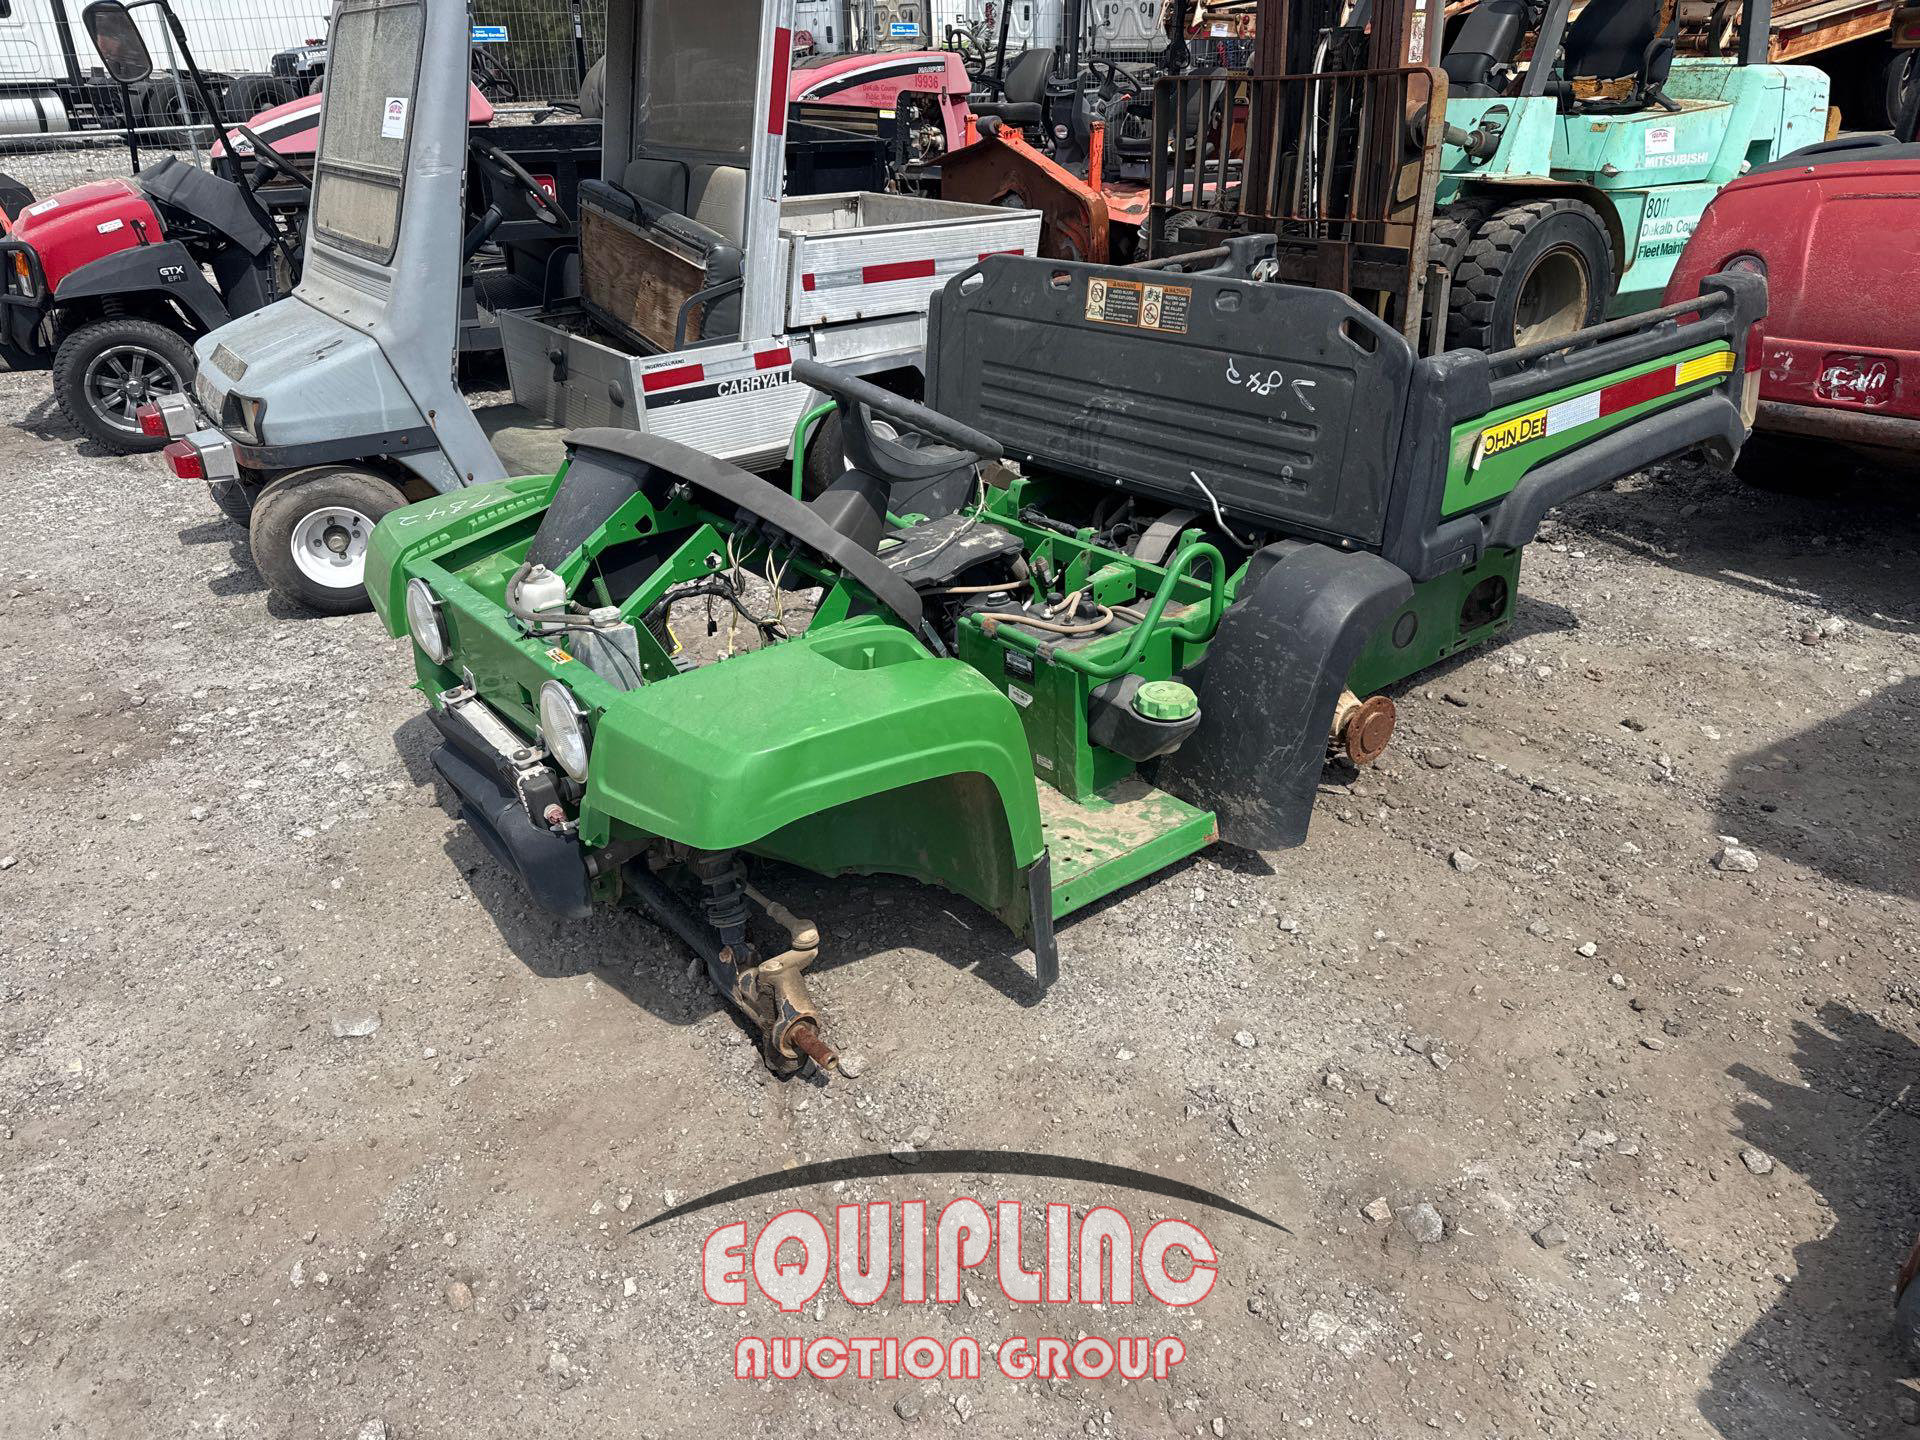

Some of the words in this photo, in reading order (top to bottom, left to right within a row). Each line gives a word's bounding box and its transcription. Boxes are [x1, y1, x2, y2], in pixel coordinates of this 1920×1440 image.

[914, 75, 939, 89] 19936
[1645, 152, 1709, 168] MITSUBISHI
[1646, 197, 1670, 219] 8011
[1638, 245, 1661, 259] Fleet
[159, 265, 185, 276] GTX
[717, 370, 797, 397] CARRYALL
[1484, 426, 1518, 453] OHN
